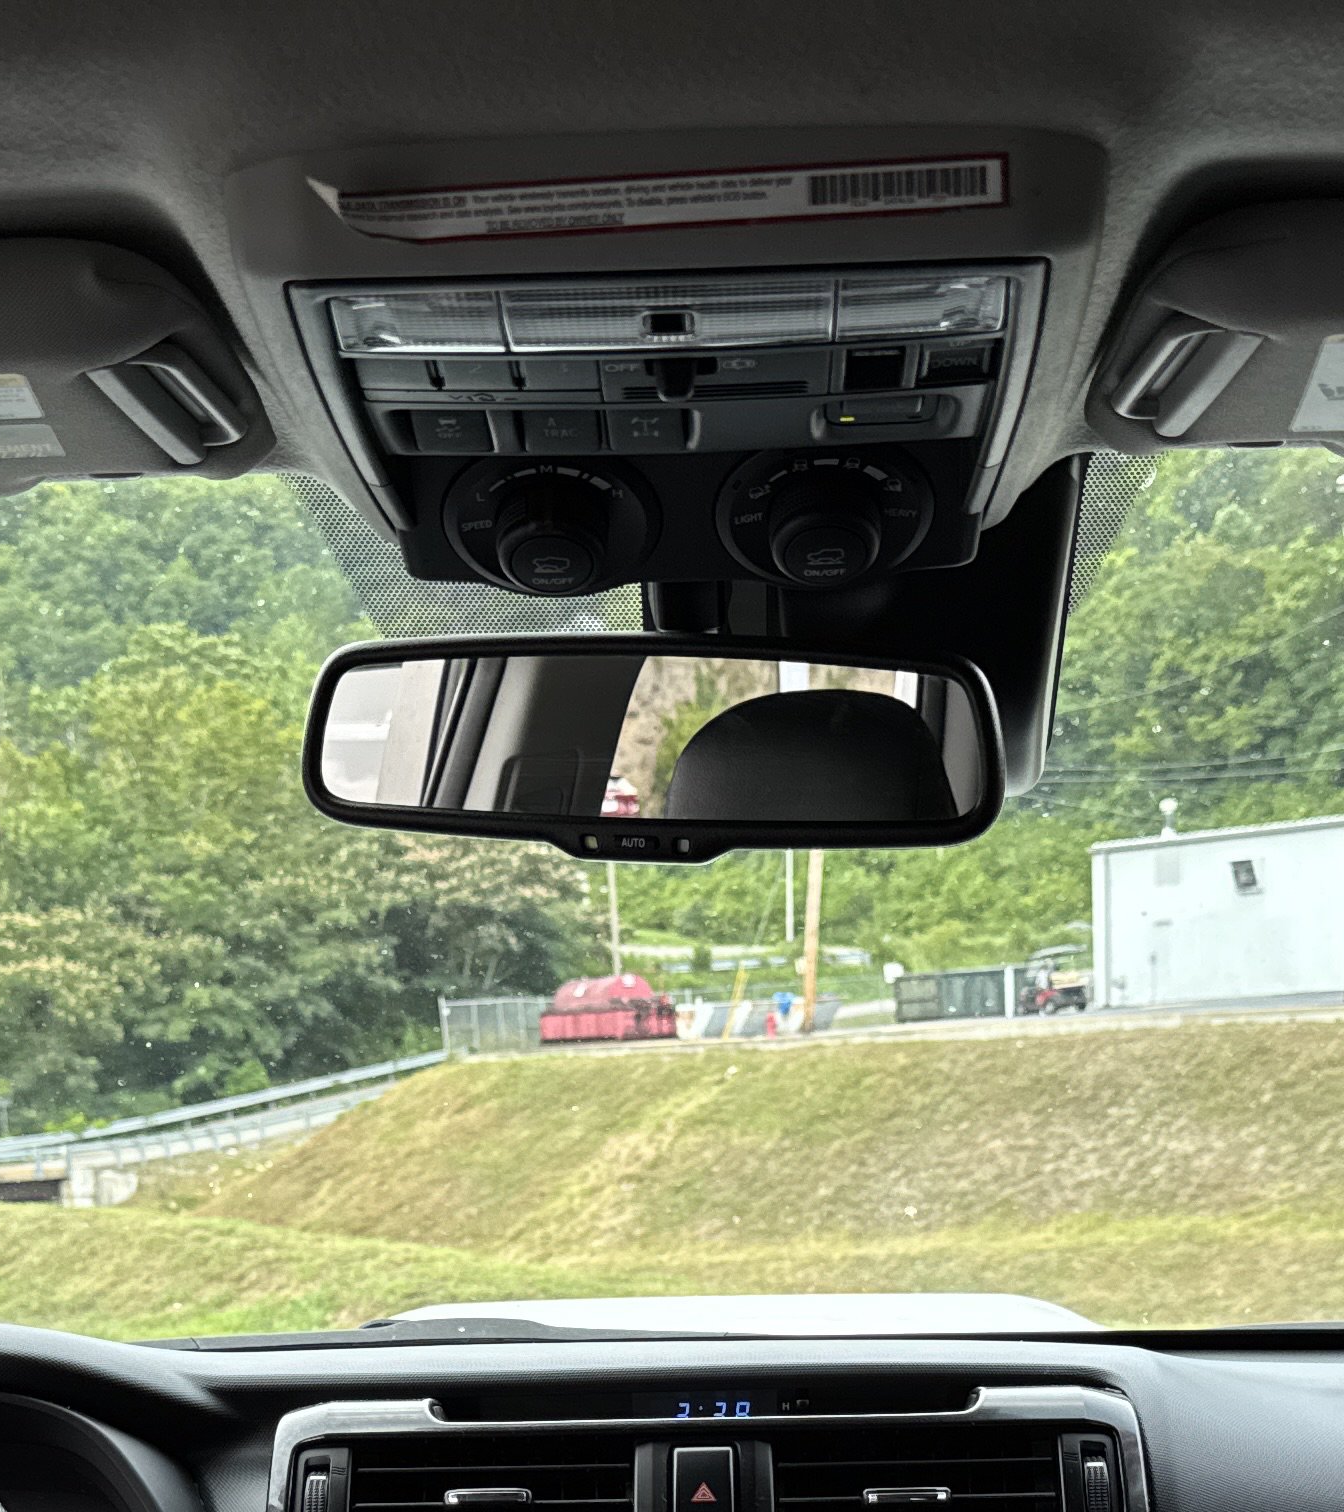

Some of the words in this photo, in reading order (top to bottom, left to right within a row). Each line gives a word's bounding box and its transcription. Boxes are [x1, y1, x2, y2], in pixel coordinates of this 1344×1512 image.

[930, 355, 978, 369] DOWN
[605, 363, 642, 374] OFF
[540, 465, 553, 474] M
[476, 492, 485, 502] L
[612, 489, 623, 498] H
[734, 512, 763, 525] LIGHT
[461, 519, 493, 532] SPEED
[803, 569, 847, 577] ON/OFF
[532, 577, 575, 585] ON/OFF
[620, 837, 646, 848] AUTO
